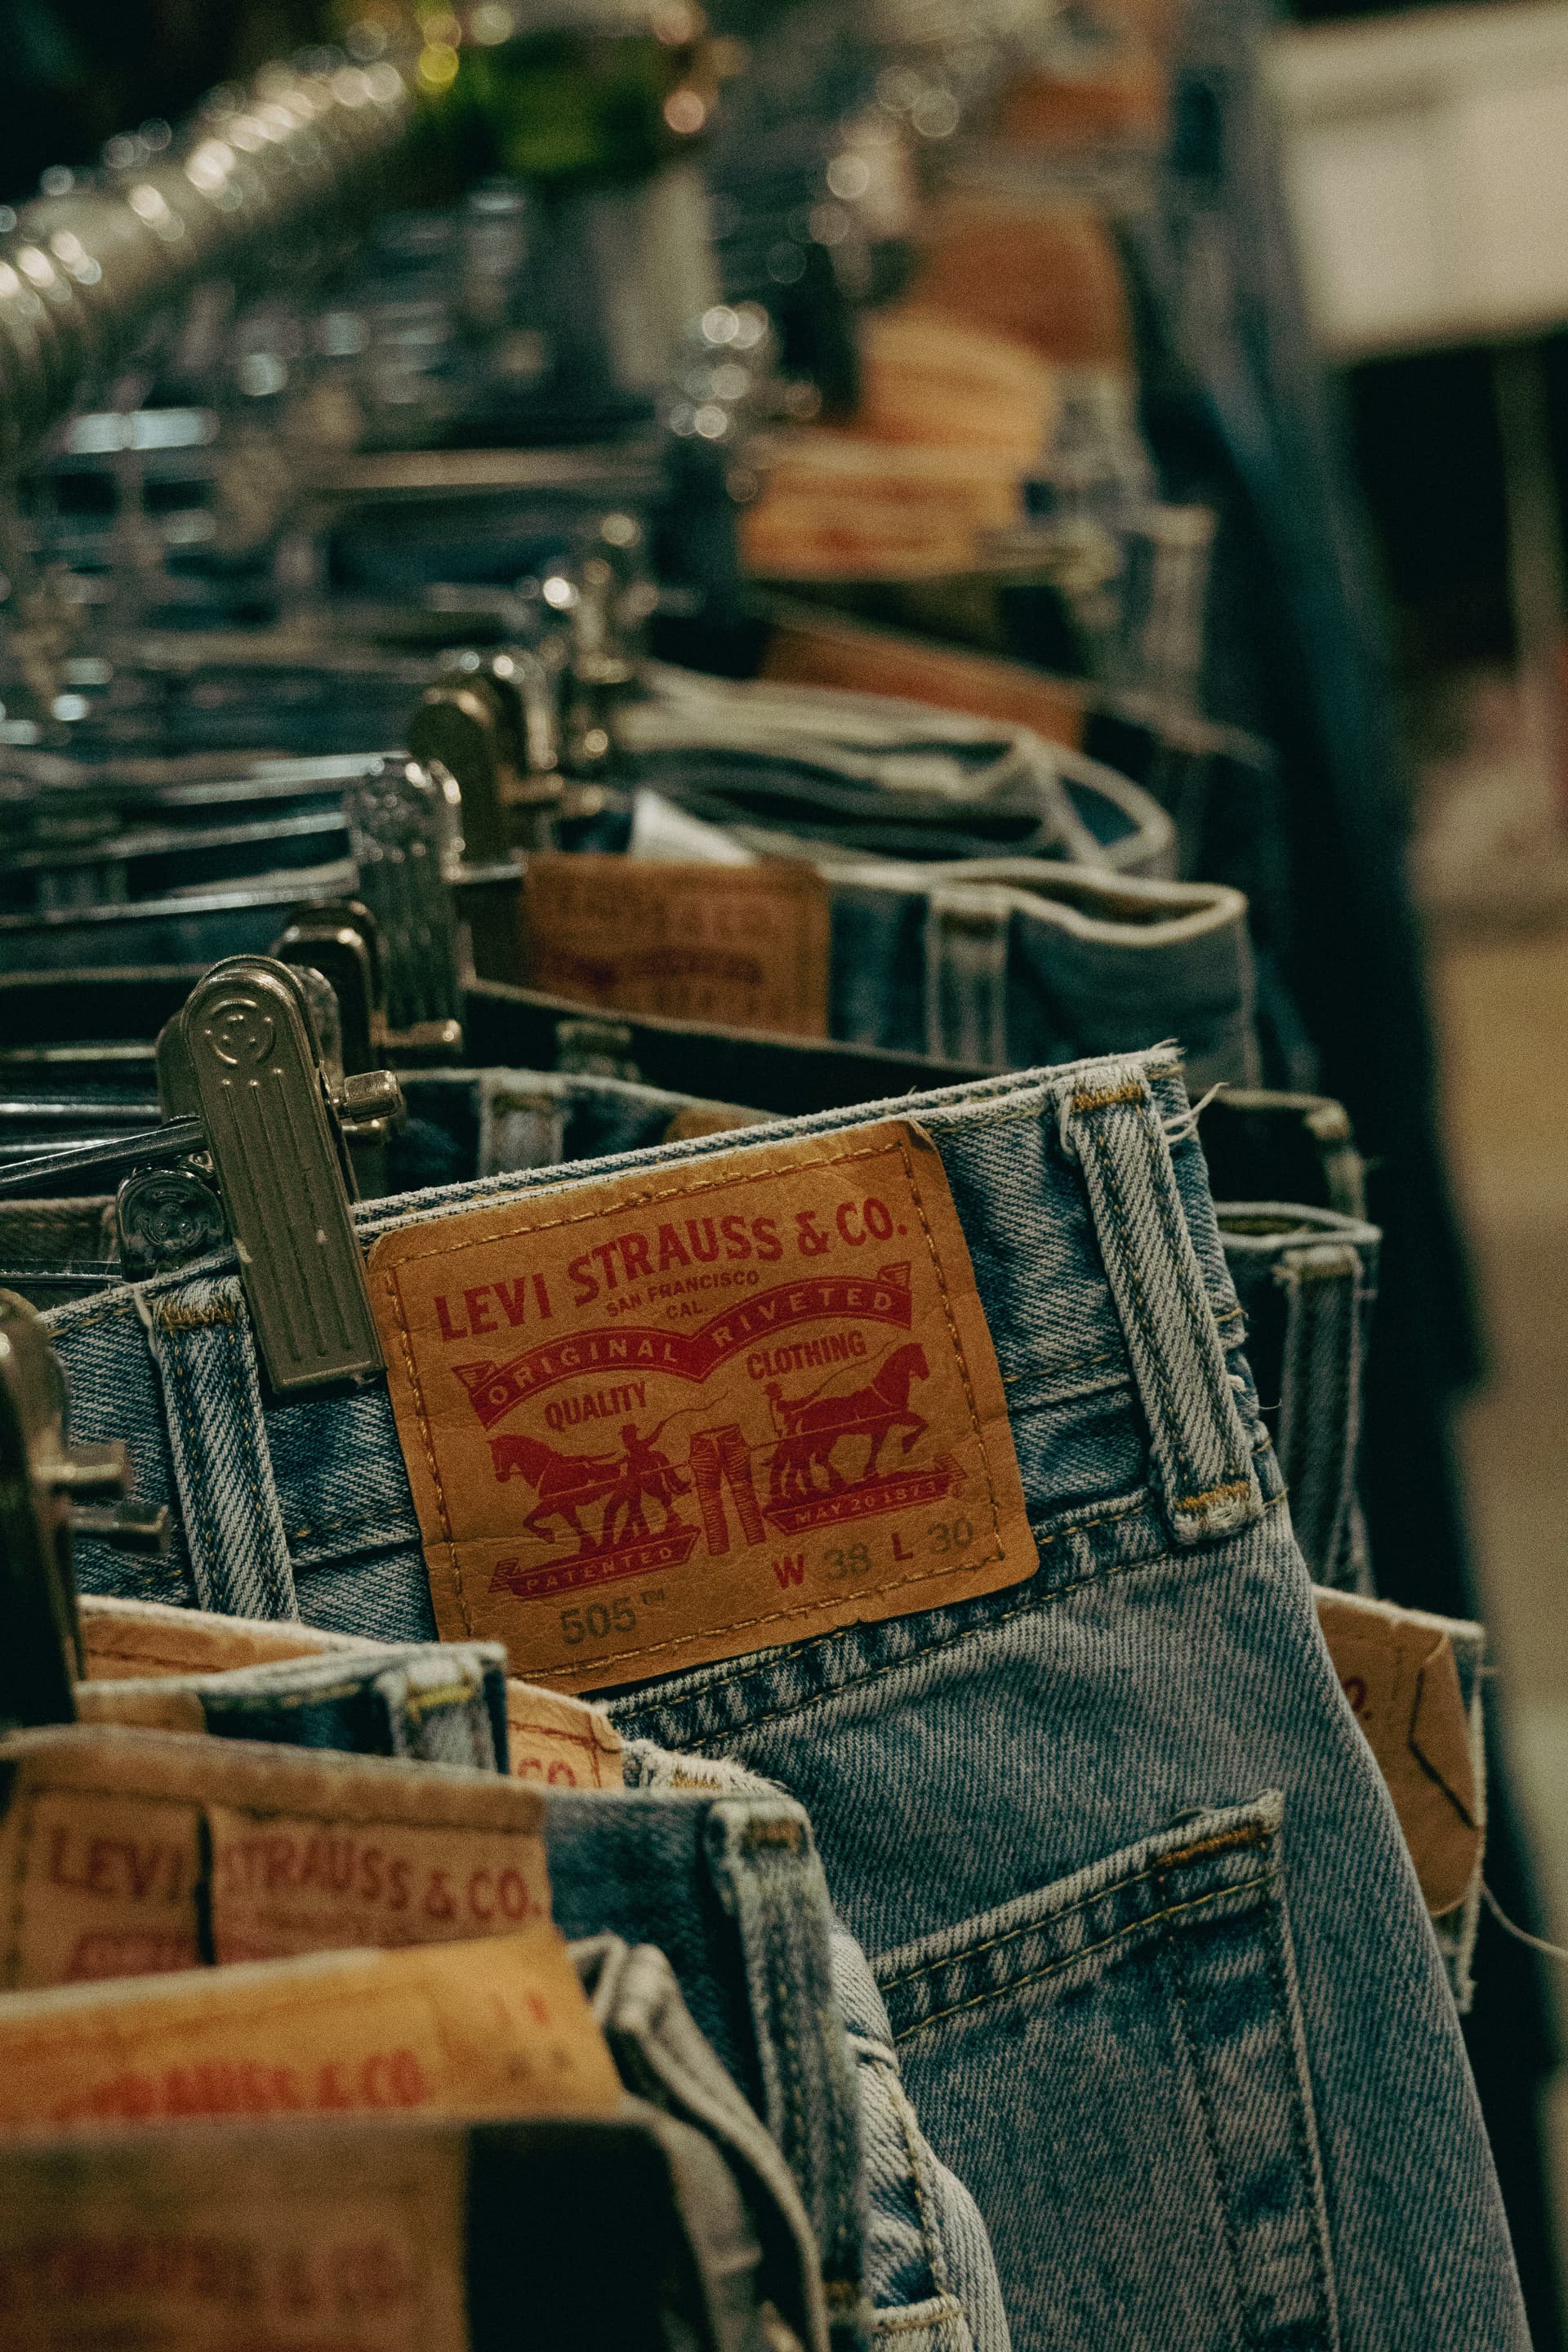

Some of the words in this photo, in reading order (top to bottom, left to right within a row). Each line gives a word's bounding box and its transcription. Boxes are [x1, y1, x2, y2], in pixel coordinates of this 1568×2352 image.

[433, 1272, 553, 1341] LEVI
[567, 1214, 785, 1307] STRAUSS
[796, 1211, 831, 1257] &
[835, 1197, 908, 1246] CO.
[605, 1293, 643, 1317] SAN
[647, 1269, 760, 1303] FRANCISCO
[489, 1339, 678, 1405] ORIGINAL
[710, 1287, 893, 1349] RIVETED
[544, 1382, 647, 1432] QUALITY
[746, 1330, 866, 1380] CLOTHING
[795, 1502, 842, 1524] MAY
[850, 1495, 875, 1511] 20
[884, 1481, 938, 1503] 1873
[527, 1547, 672, 1591] PATENTED
[773, 1554, 804, 1589] W
[823, 1543, 872, 1580] 38
[891, 1531, 922, 1561] L
[928, 1517, 973, 1552] 30
[49, 1827, 185, 1904] LEVI
[466, 1869, 543, 1922] CO.
